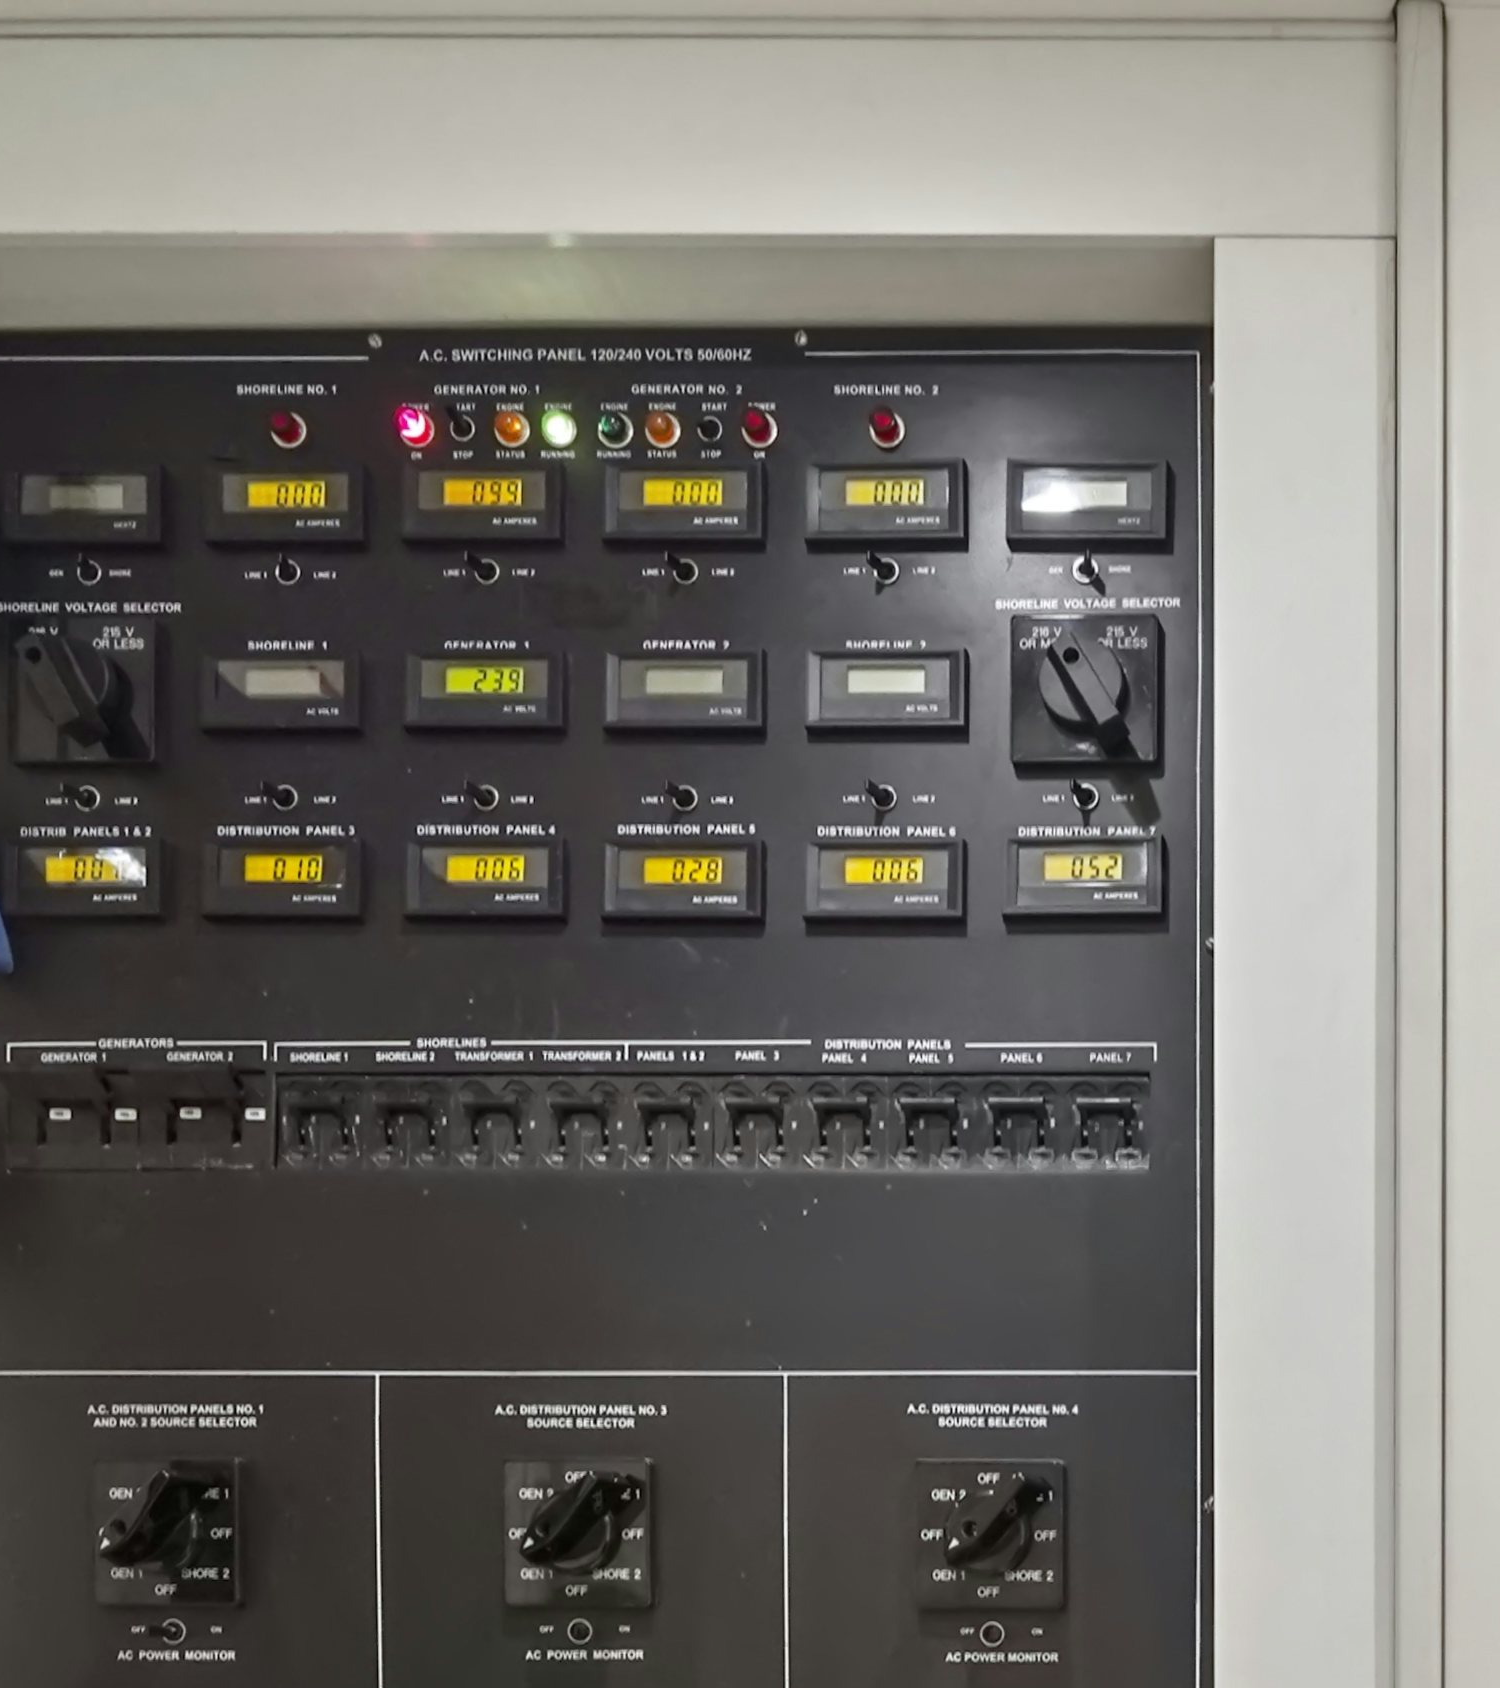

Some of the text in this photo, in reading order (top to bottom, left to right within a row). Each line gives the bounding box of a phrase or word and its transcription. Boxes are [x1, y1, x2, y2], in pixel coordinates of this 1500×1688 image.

[420, 348, 751, 361] A.C. SWITCHING PANEL 120/240 VOLTS 50/60HZ
[237, 384, 336, 395] SHORELINE NO. 1
[434, 384, 539, 395] GENERATOR NO. 1
[631, 384, 742, 394] GENERATOR NO. 2
[834, 385, 938, 395] SHORELINE NO. 2
[276, 483, 323, 507] 000
[473, 481, 519, 505] 099
[673, 481, 719, 505] 000
[874, 481, 920, 505] 000
[995, 598, 1180, 610] SHORELINE VOLTAGE SELECTOR
[474, 668, 520, 692] 239
[20, 826, 151, 837] DISTRIB PANELS 1 & 2
[417, 825, 555, 835] DISTRIBUTION PANEL 4
[618, 824, 755, 835] DISTRIBUTION PANEL 5
[1018, 826, 1155, 837] DISTRIBUTION PANEL 7
[273, 857, 321, 881] 010
[475, 856, 519, 881] 006
[672, 858, 719, 882] 028
[872, 858, 918, 882] 006
[1071, 855, 1119, 880] 052
[98, 1038, 173, 1049] GENERATORS
[417, 1038, 486, 1048] SHORELINES
[825, 1039, 951, 1050] DISTRIBUTION PANELS
[41, 1052, 106, 1062] GENERATOR 1
[455, 1051, 533, 1061] TRANSFORMER 1
[637, 1051, 704, 1061] PANELS 1 & 2
[1001, 1053, 1042, 1063] PANEL 6
[1090, 1052, 1131, 1062] PANEL 7
[88, 1404, 263, 1414] A.C. DISTRIBUTION PANELS NO. 1
[907, 1404, 929, 1414] A.C.
[932, 1404, 1009, 1414] DISTRIBUTION
[1013, 1404, 1049, 1415] PANEL
[1072, 1405, 1078, 1414] 4
[94, 1417, 256, 1427] AND NO. 2 SOURCE SELECTOR
[939, 1417, 1047, 1427] SOURCE SELECTOR
[978, 1473, 999, 1484] OFF
[977, 1587, 999, 1598] OFF
[946, 1652, 1058, 1662] AC POWER MONITOR
